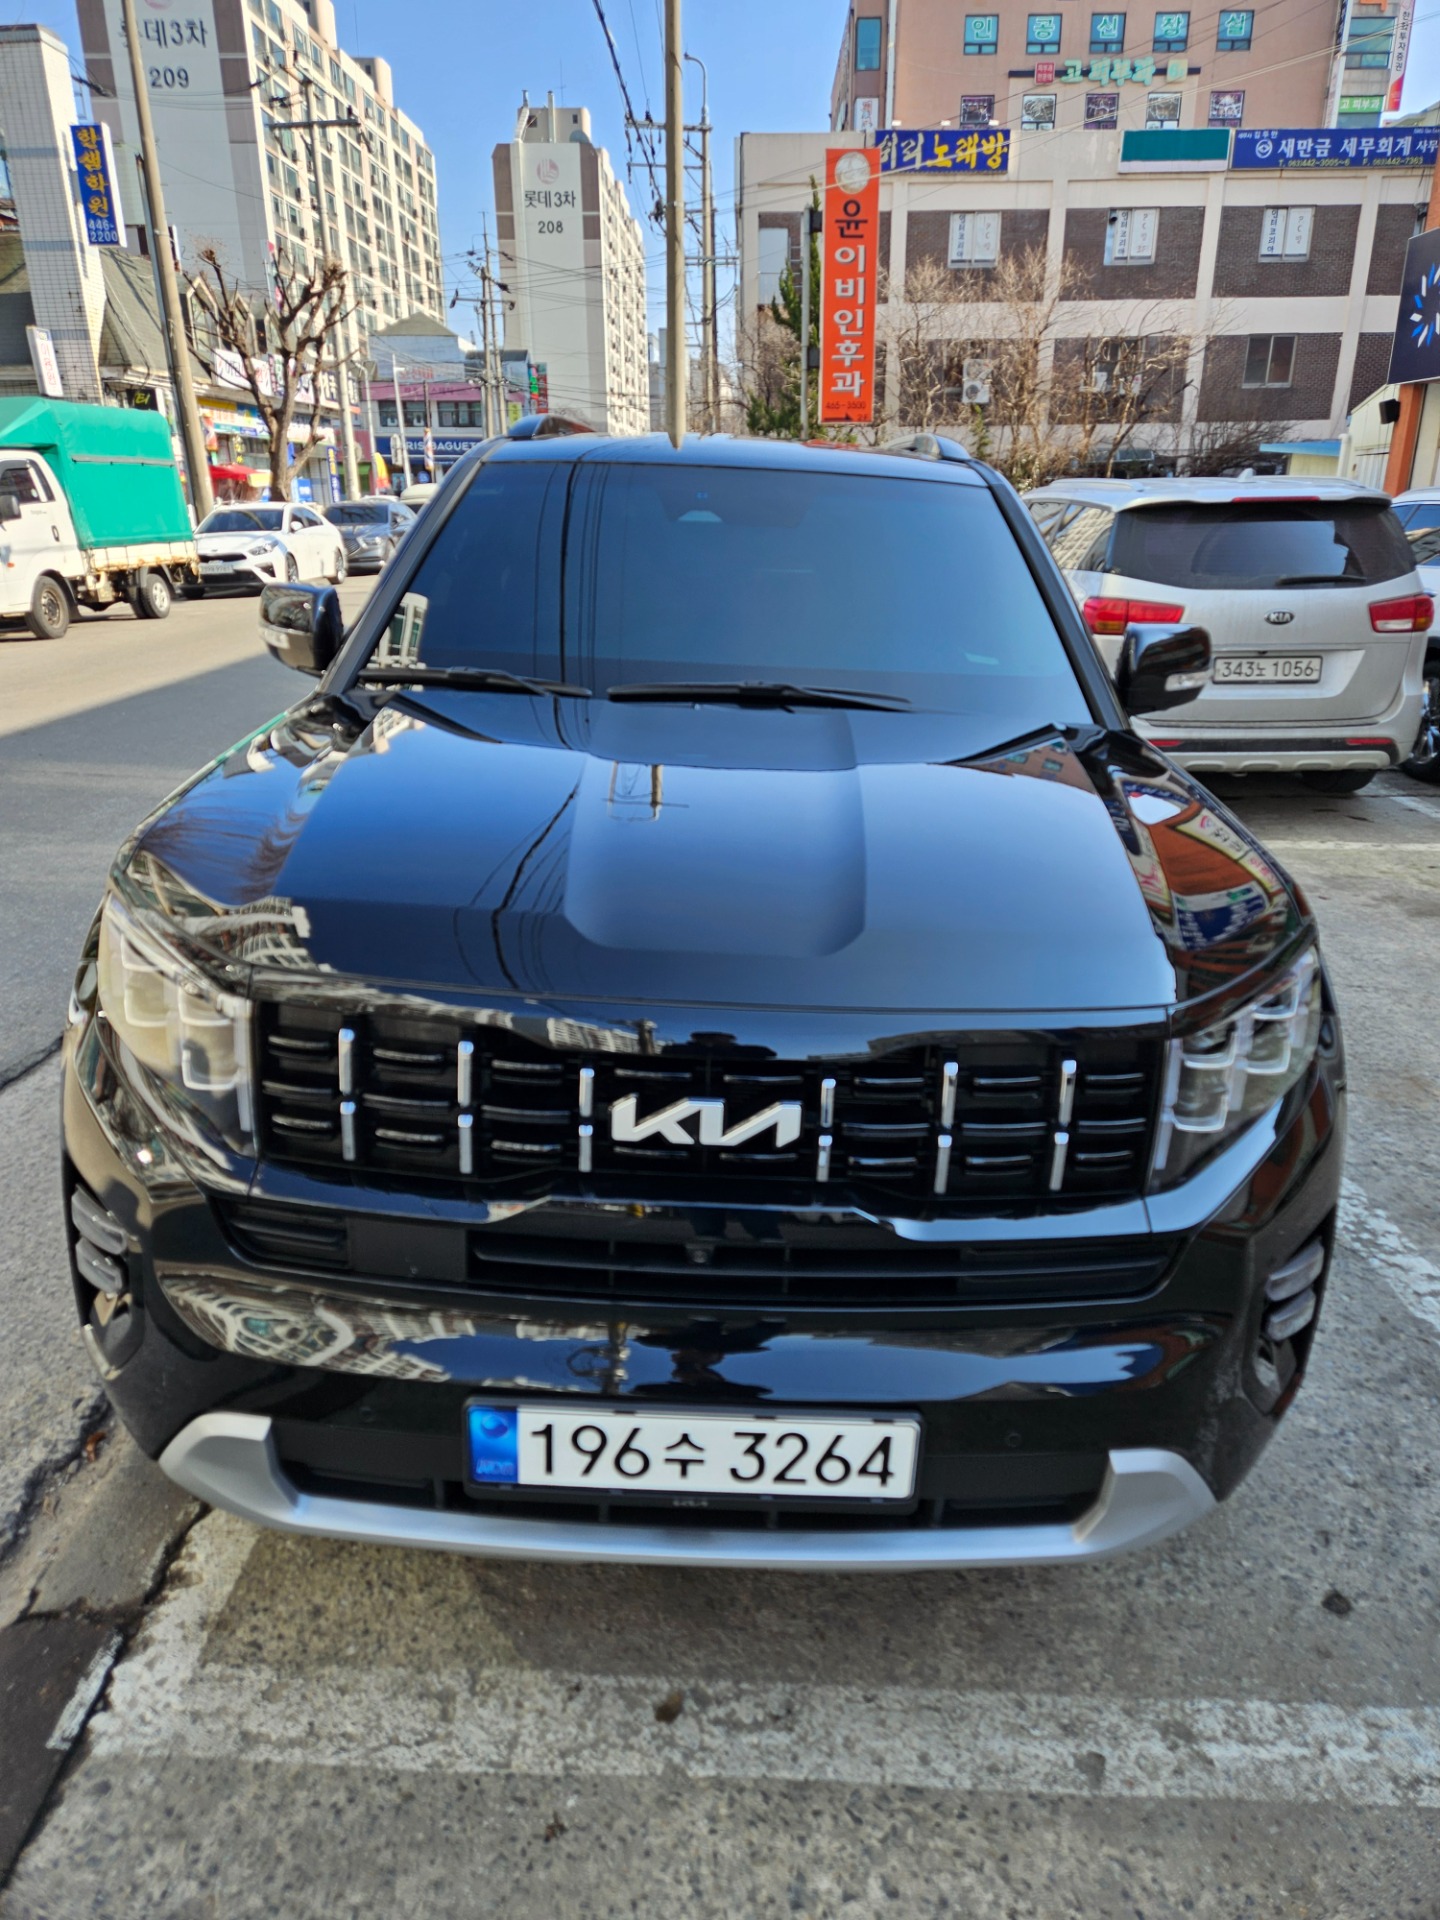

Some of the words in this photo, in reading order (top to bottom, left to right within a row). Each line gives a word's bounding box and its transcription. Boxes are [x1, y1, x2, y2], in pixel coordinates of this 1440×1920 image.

[149, 67, 189, 88] 209
[1277, 138, 1332, 158] 새만금
[1340, 136, 1412, 157] 세무회계
[524, 190, 577, 208] 롯데3차
[537, 220, 564, 234] 208
[89, 231, 118, 243] 2200
[1269, 611, 1291, 622] KIA
[1222, 661, 1266, 678] 343노
[1272, 660, 1314, 677] 1056
[610, 1092, 803, 1149] KIA
[530, 1423, 706, 1479] 196수
[729, 1431, 895, 1488] 3264
